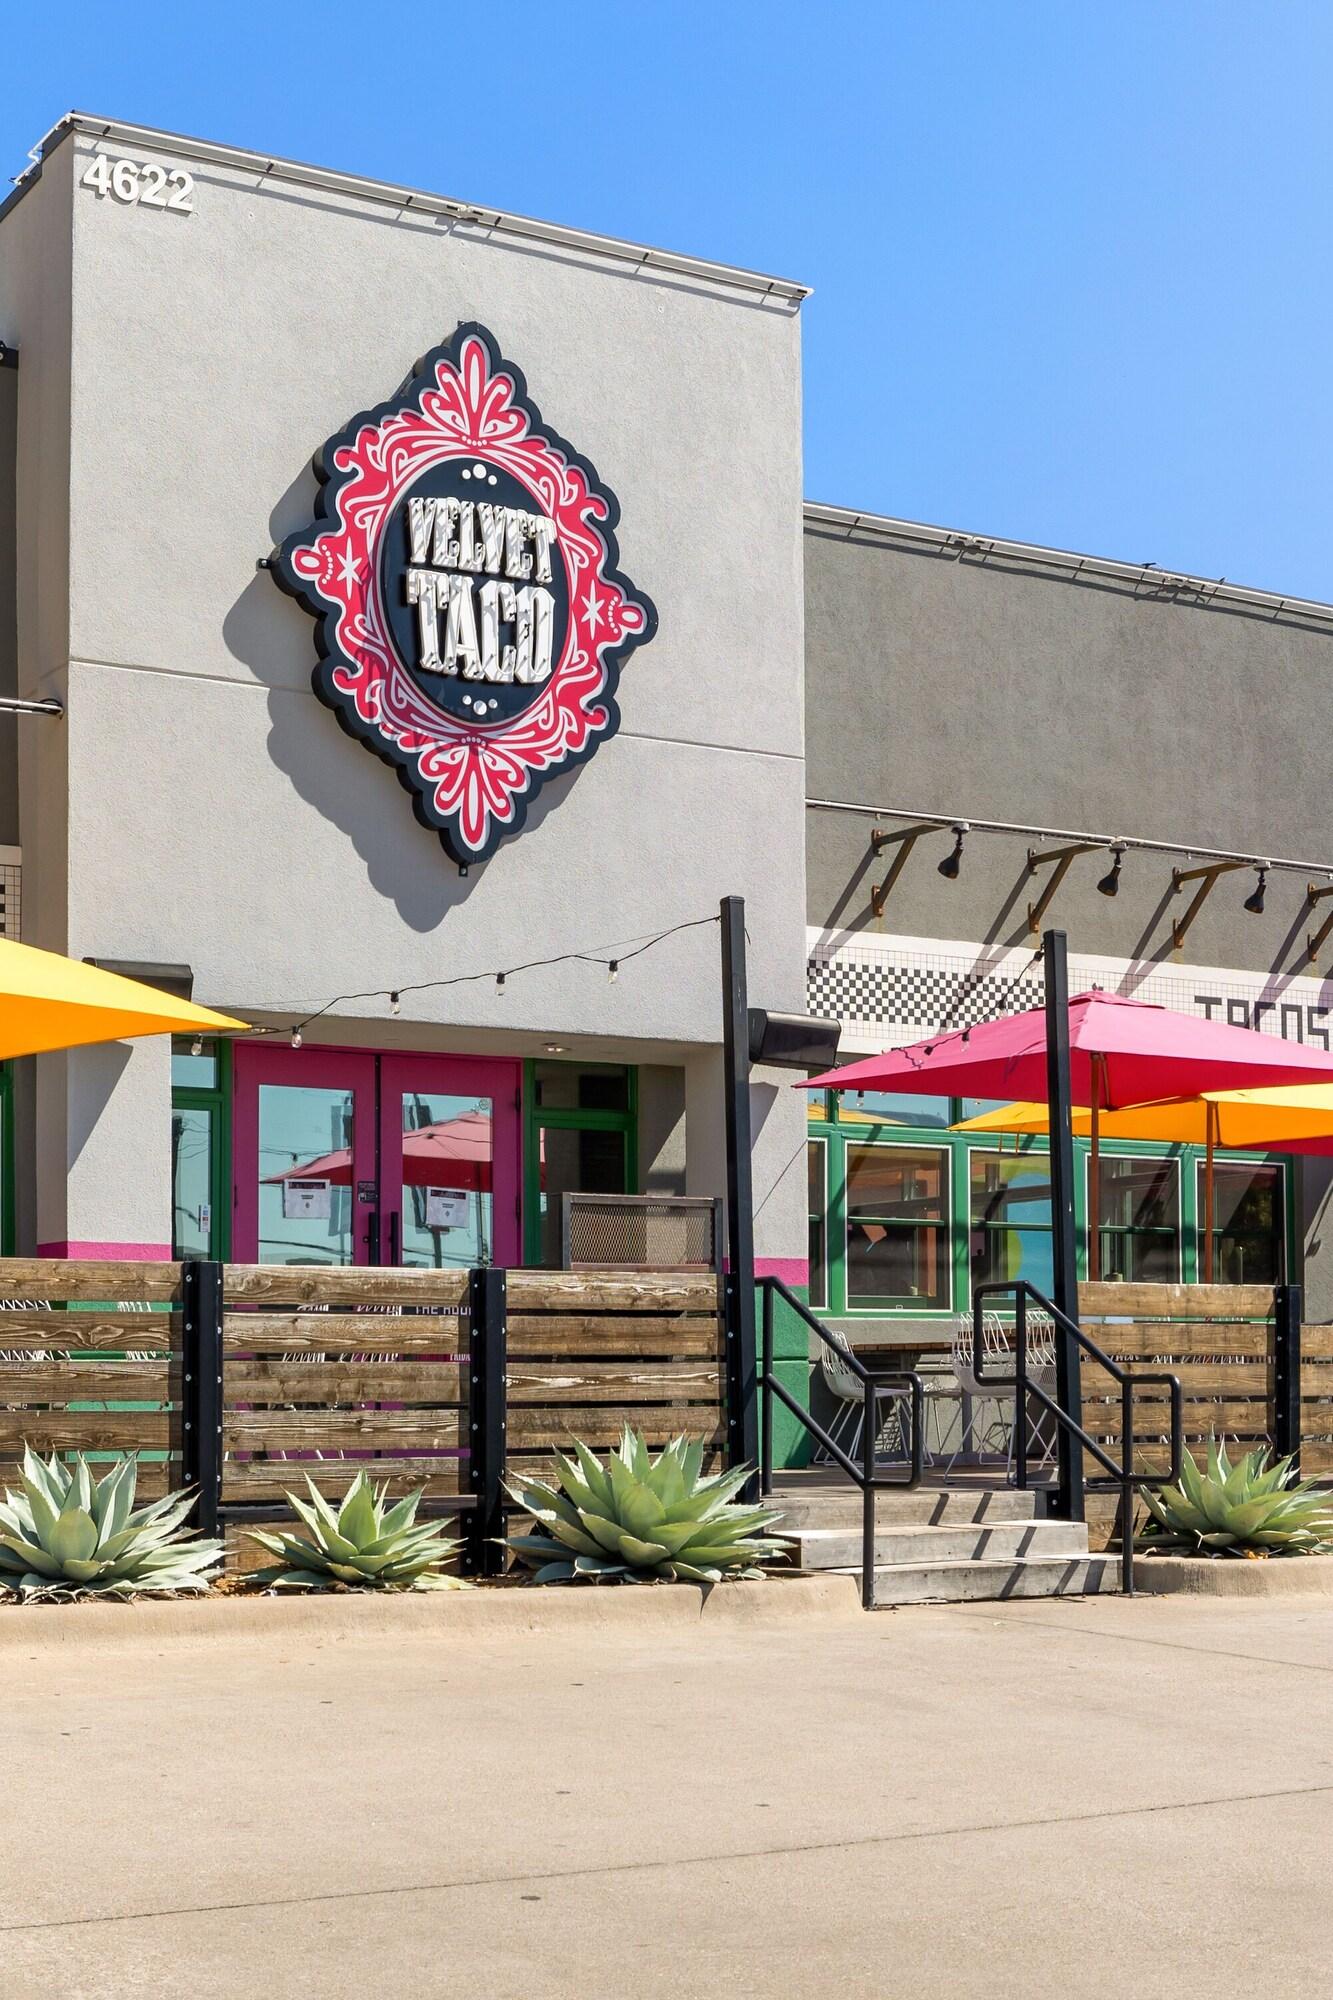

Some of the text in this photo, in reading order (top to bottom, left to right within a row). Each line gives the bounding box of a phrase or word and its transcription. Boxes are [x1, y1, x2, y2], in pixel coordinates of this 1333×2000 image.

[84, 154, 193, 211] 4622
[408, 497, 557, 583] VELVET
[407, 568, 555, 683] TACO
